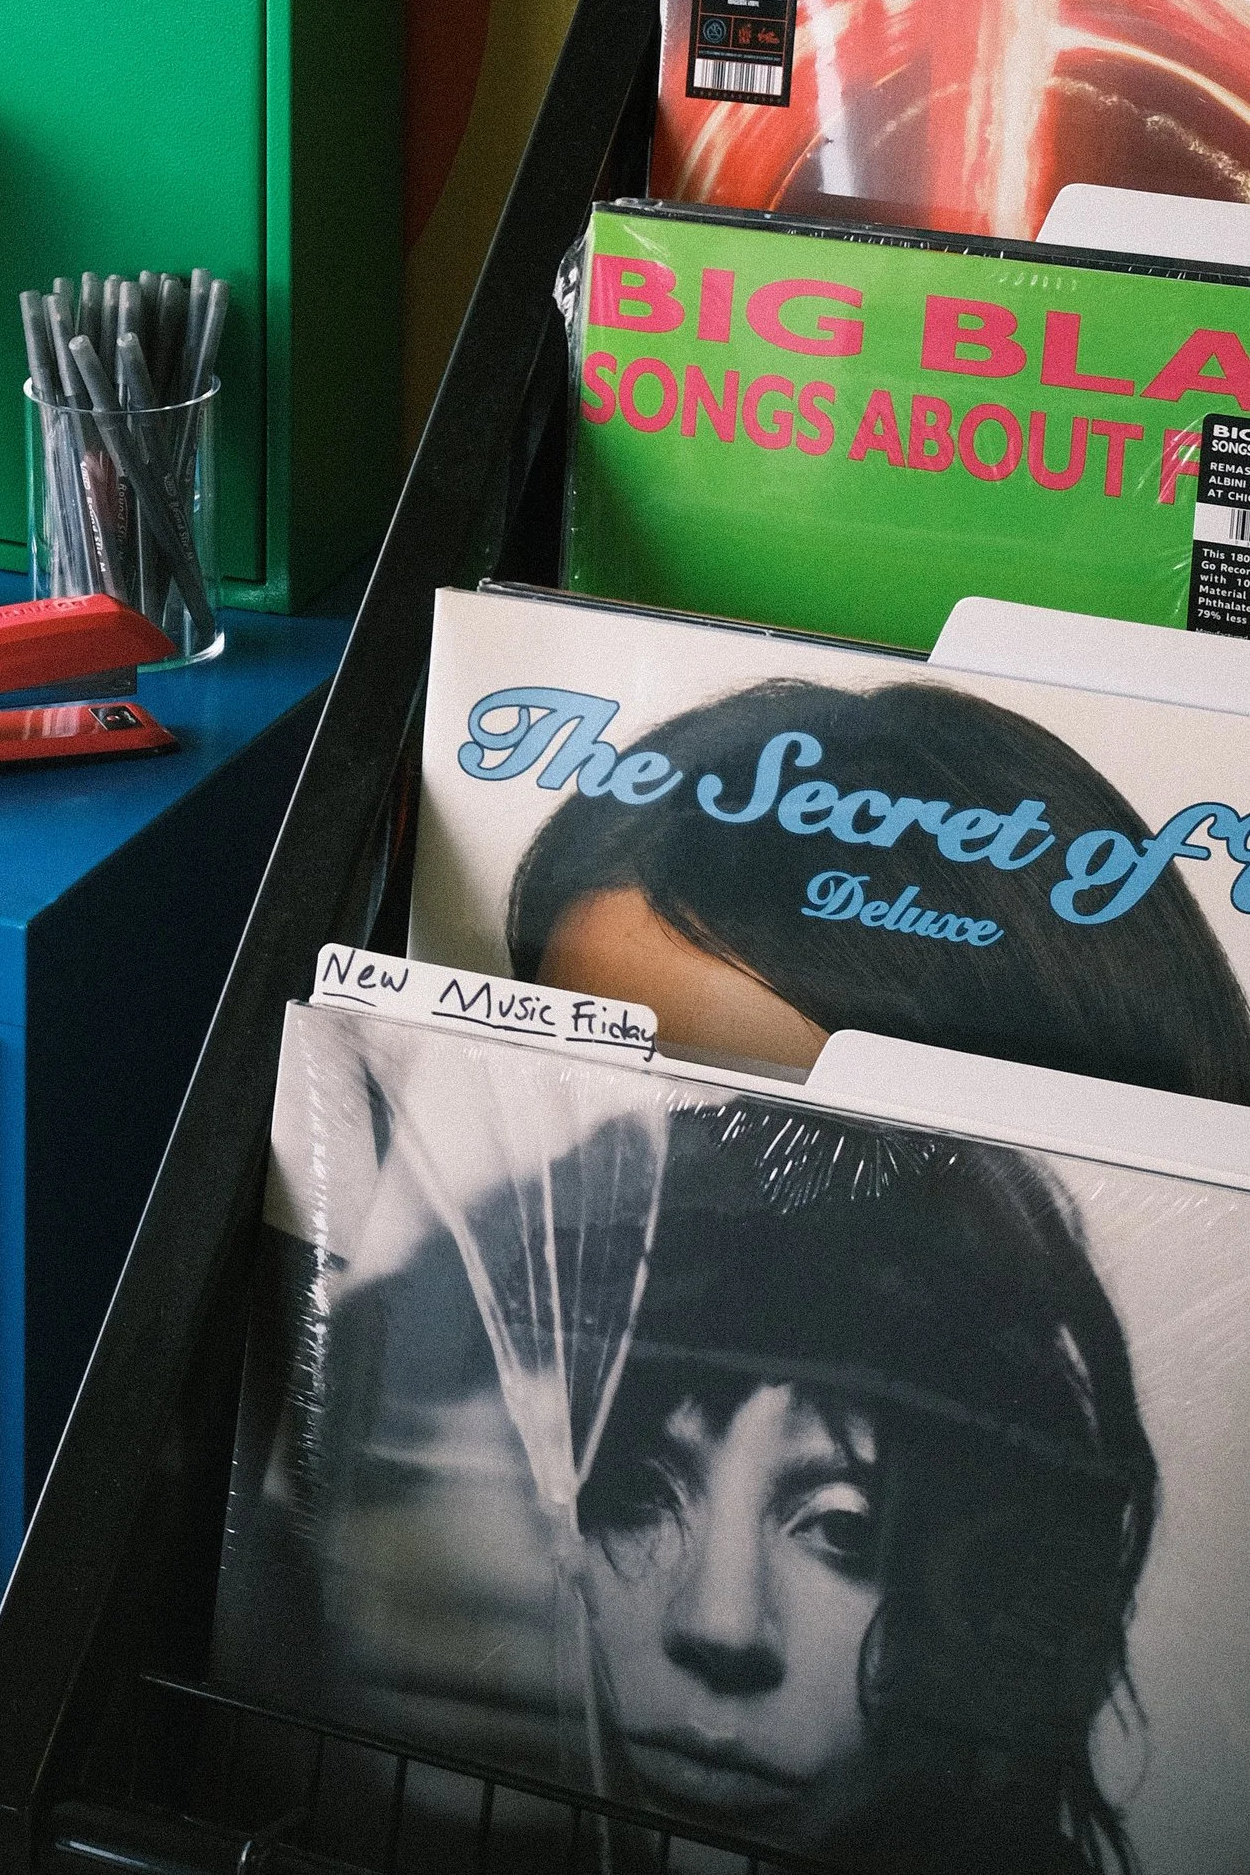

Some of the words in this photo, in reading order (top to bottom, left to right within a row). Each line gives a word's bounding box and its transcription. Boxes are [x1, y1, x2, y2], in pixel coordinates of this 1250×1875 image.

[587, 252, 865, 358] BIG
[580, 350, 836, 457] SONGS
[847, 388, 1144, 498] ABOUT
[1208, 474, 1247, 489] ALBINI
[1207, 488, 1225, 499] AT
[117, 483, 127, 523] Round
[1202, 548, 1226, 560] This
[1201, 560, 1216, 571] Go
[1199, 573, 1227, 585] with
[1198, 584, 1247, 600] Material
[1197, 608, 1221, 621] 79%
[1226, 612, 1248, 625] less
[456, 685, 683, 806] The
[695, 730, 1056, 872] Secret
[1047, 800, 1212, 927] of
[800, 869, 1005, 949] Deluxe
[321, 948, 410, 993] New
[438, 977, 557, 1027] Music
[571, 999, 658, 1063] Friday
